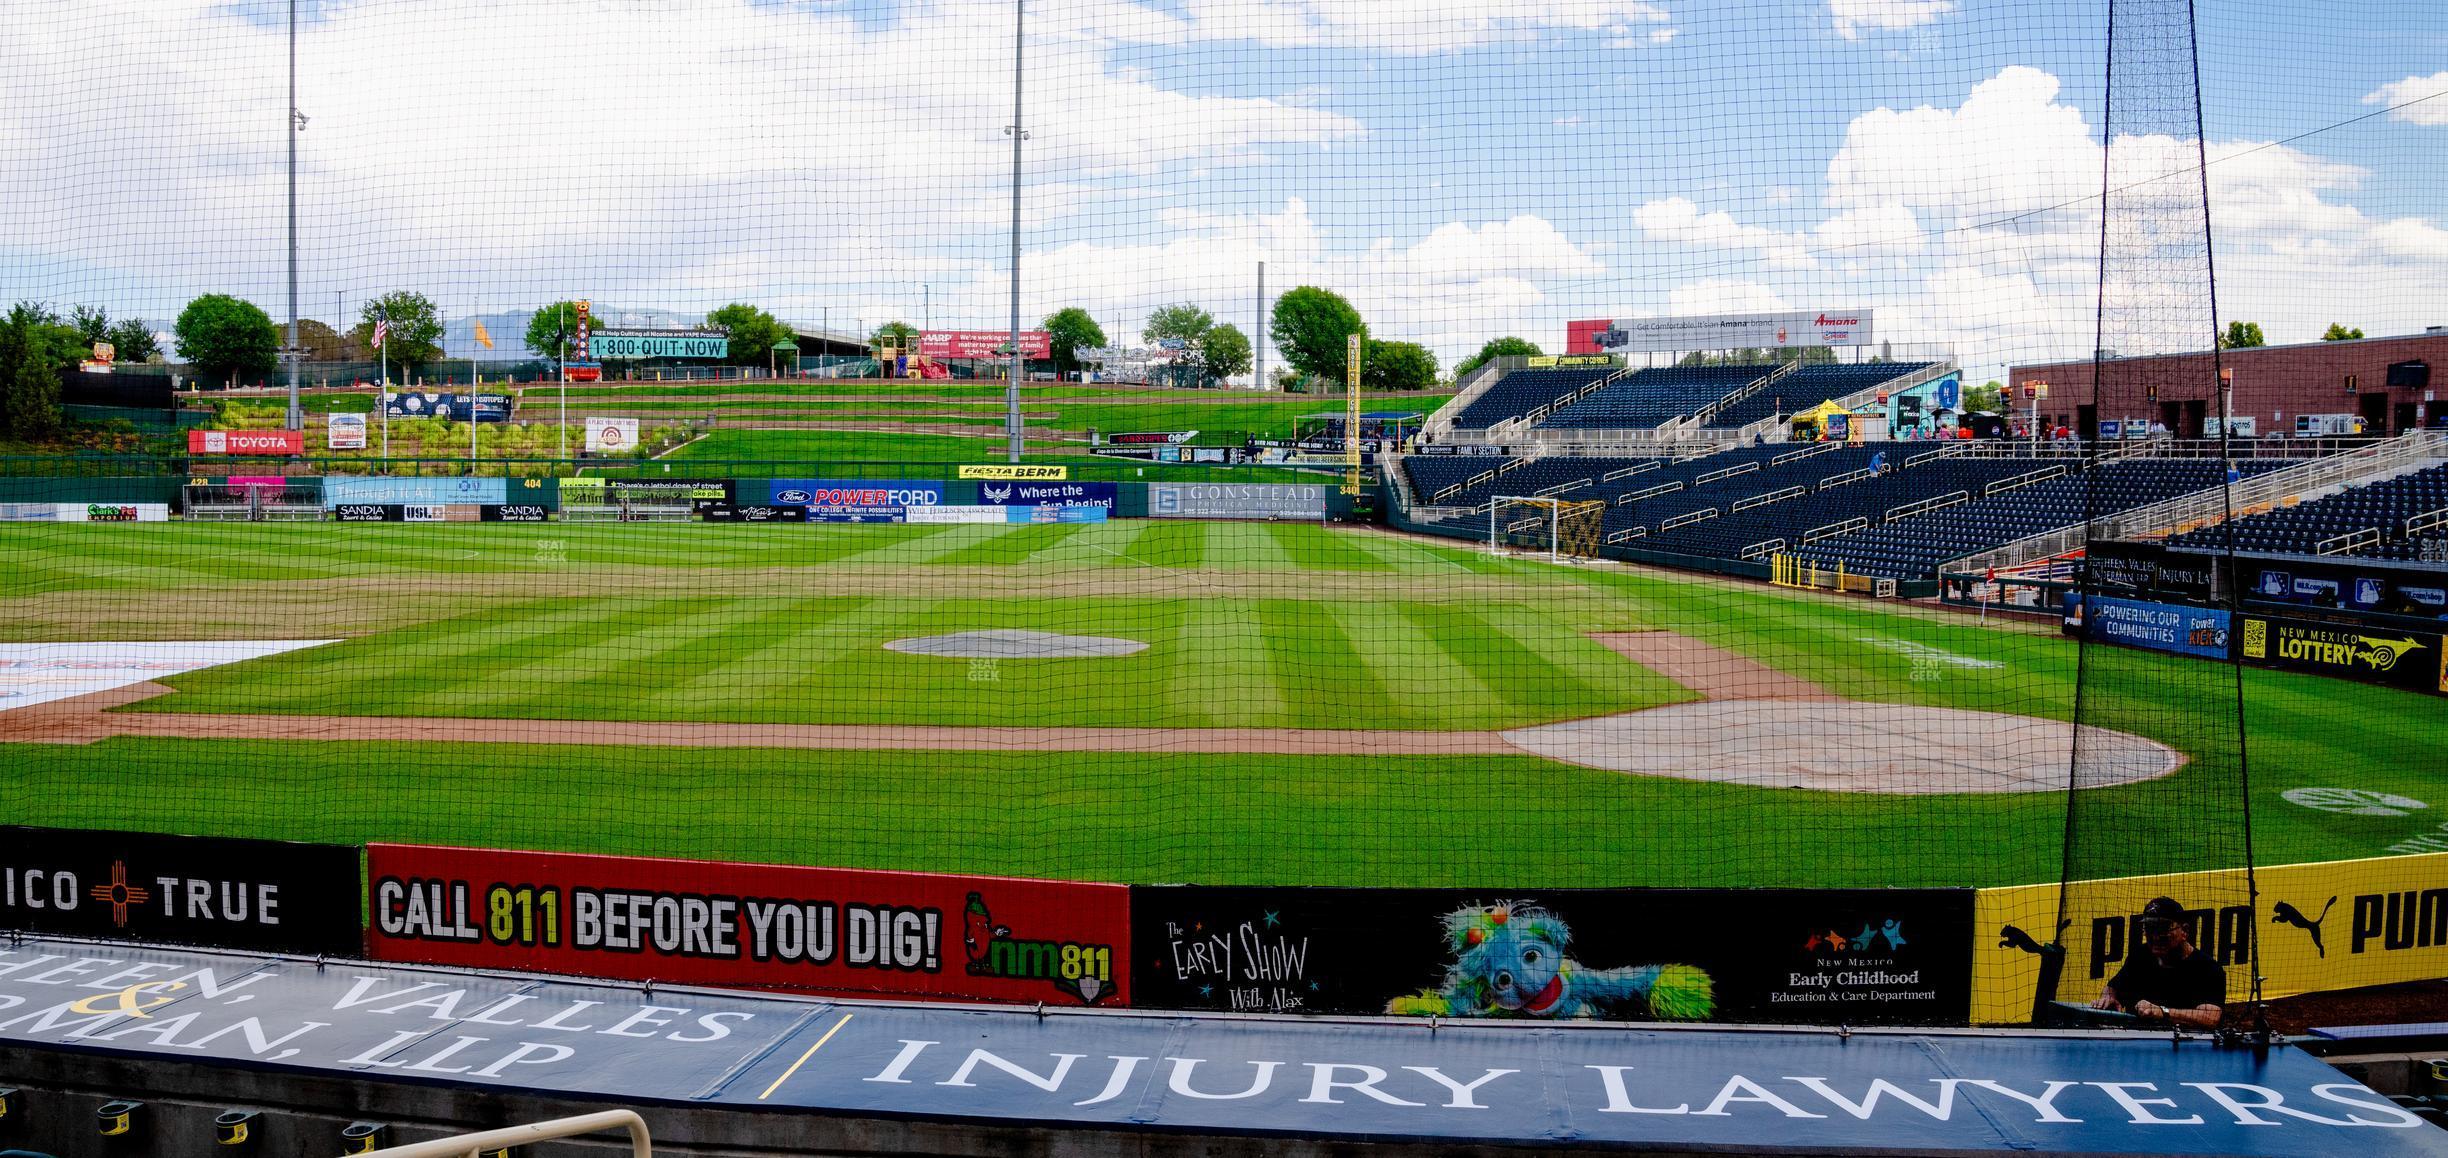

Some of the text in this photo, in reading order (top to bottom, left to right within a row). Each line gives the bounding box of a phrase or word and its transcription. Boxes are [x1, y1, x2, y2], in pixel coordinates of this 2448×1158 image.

[1814, 314, 1858, 326] Amana
[1560, 357, 1588, 366] COMMUNITY
[1589, 356, 1609, 364] CORNER
[230, 436, 288, 448] TOYOTA
[1457, 446, 1502, 455] FAMILY SECTION
[964, 467, 1061, 478] FIESTA BERM
[190, 478, 208, 486] 428
[524, 479, 542, 488] 404
[336, 486, 394, 500] Through
[706, 490, 724, 498] pills.
[783, 491, 805, 501] Ford
[1019, 484, 1084, 499] Where the
[1190, 486, 1316, 500] GONSTEAD
[1340, 486, 1356, 495] 340
[88, 504, 138, 516] Clark's Pet
[1066, 498, 1112, 508] Begins!
[340, 506, 385, 516] SANDIA
[500, 506, 544, 516] SANDIA
[2159, 567, 2196, 584] INJURY
[2103, 604, 2180, 628] POWERING OUR
[2190, 618, 2215, 630] Power
[2106, 621, 2174, 644] COMMUNITIES
[2188, 630, 2213, 646] KICK
[2280, 626, 2358, 644] NEW MEXICO
[2279, 637, 2357, 666] LOTTERY
[156, 876, 281, 926] TRUE
[378, 880, 938, 969] CALL 811 BEFORE YOU DIG!
[1166, 922, 1184, 938] The
[1172, 921, 1308, 982] EARLY SHOW
[992, 941, 1109, 982] nm811
[1789, 970, 1919, 988] Early Childhood
[70, 982, 188, 1018] &
[1229, 986, 1264, 1010] With
[1771, 990, 1936, 1002] Education & Care Department
[332, 976, 754, 1042] VALLES
[338, 1030, 575, 1078] LLP
[862, 1038, 2423, 1128] INJURY LAWYERS
